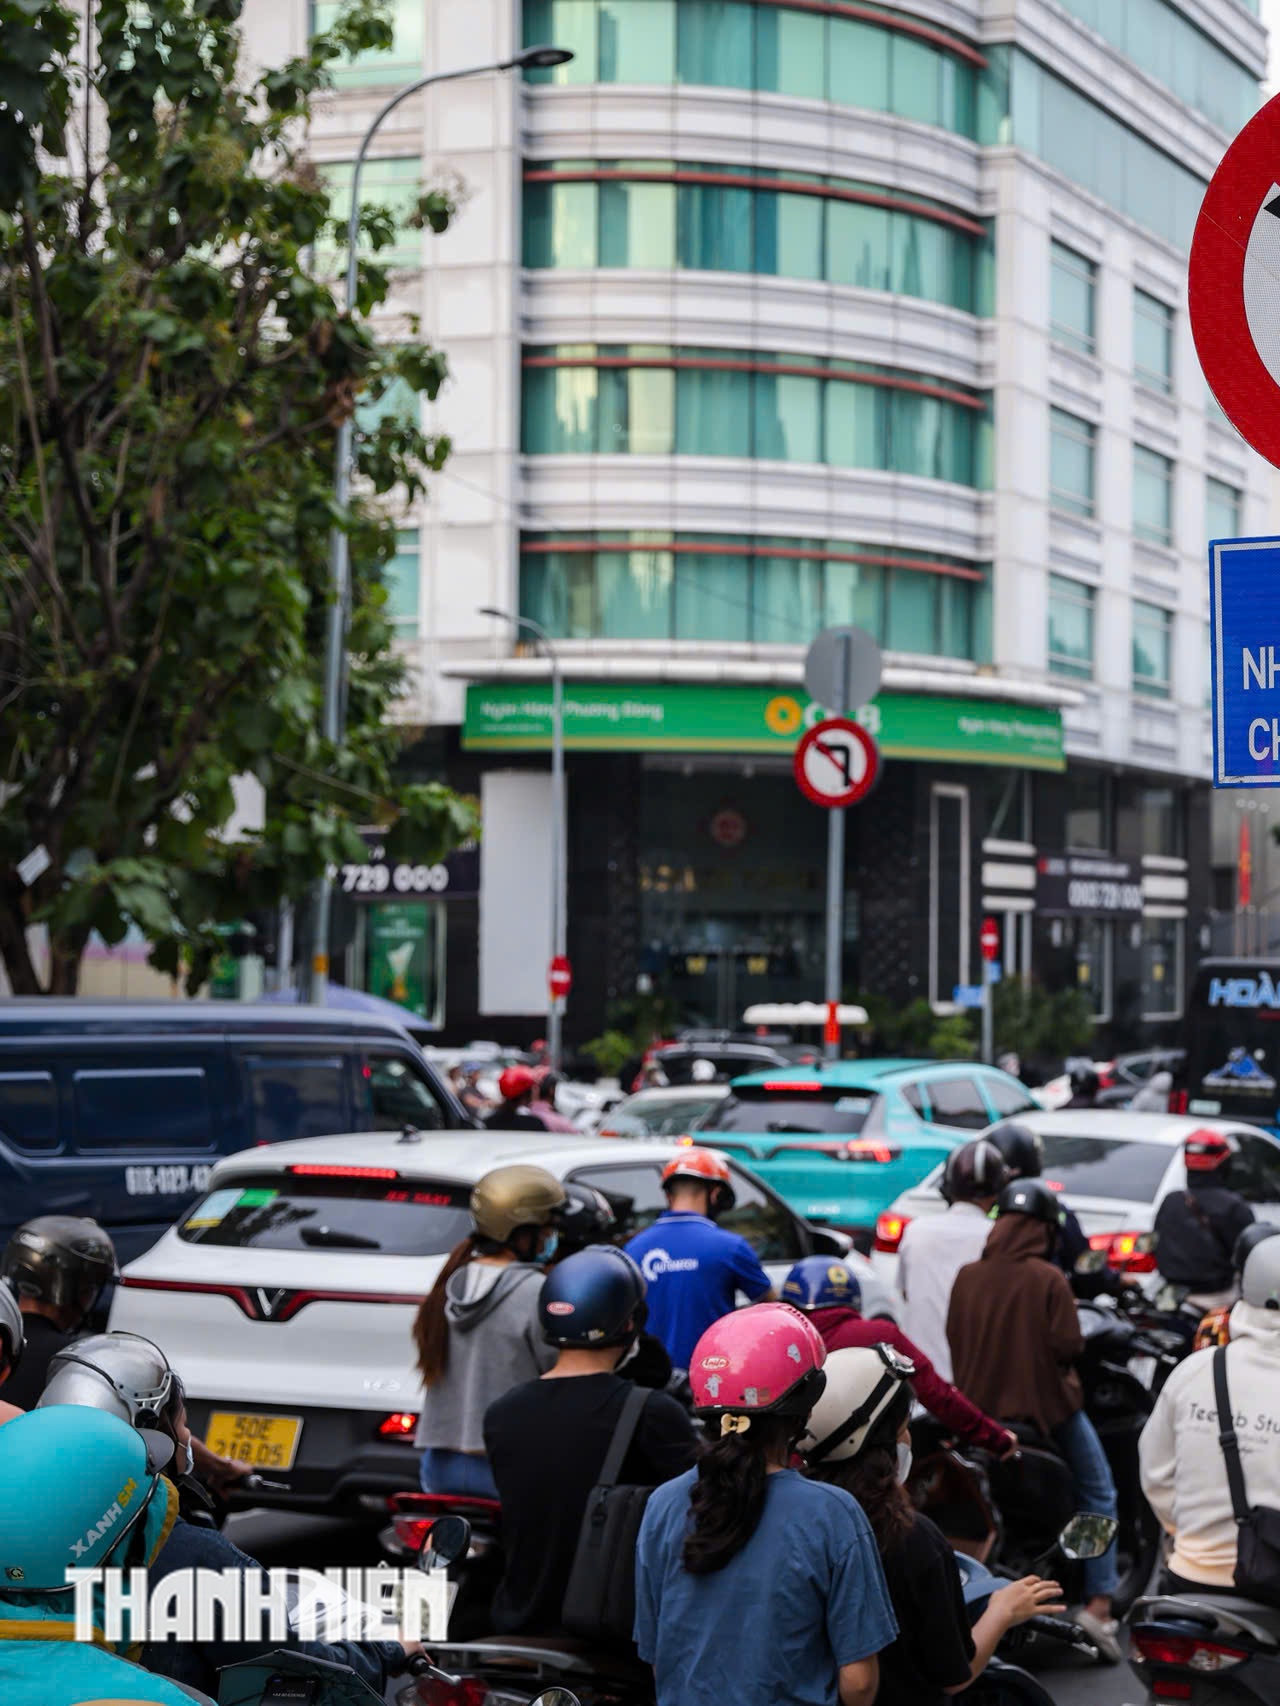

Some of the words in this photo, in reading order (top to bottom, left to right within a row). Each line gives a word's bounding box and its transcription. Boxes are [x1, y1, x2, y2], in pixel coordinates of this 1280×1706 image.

[341, 864, 390, 892] 729
[393, 864, 449, 892] 000
[69, 1502, 123, 1559] XANH
